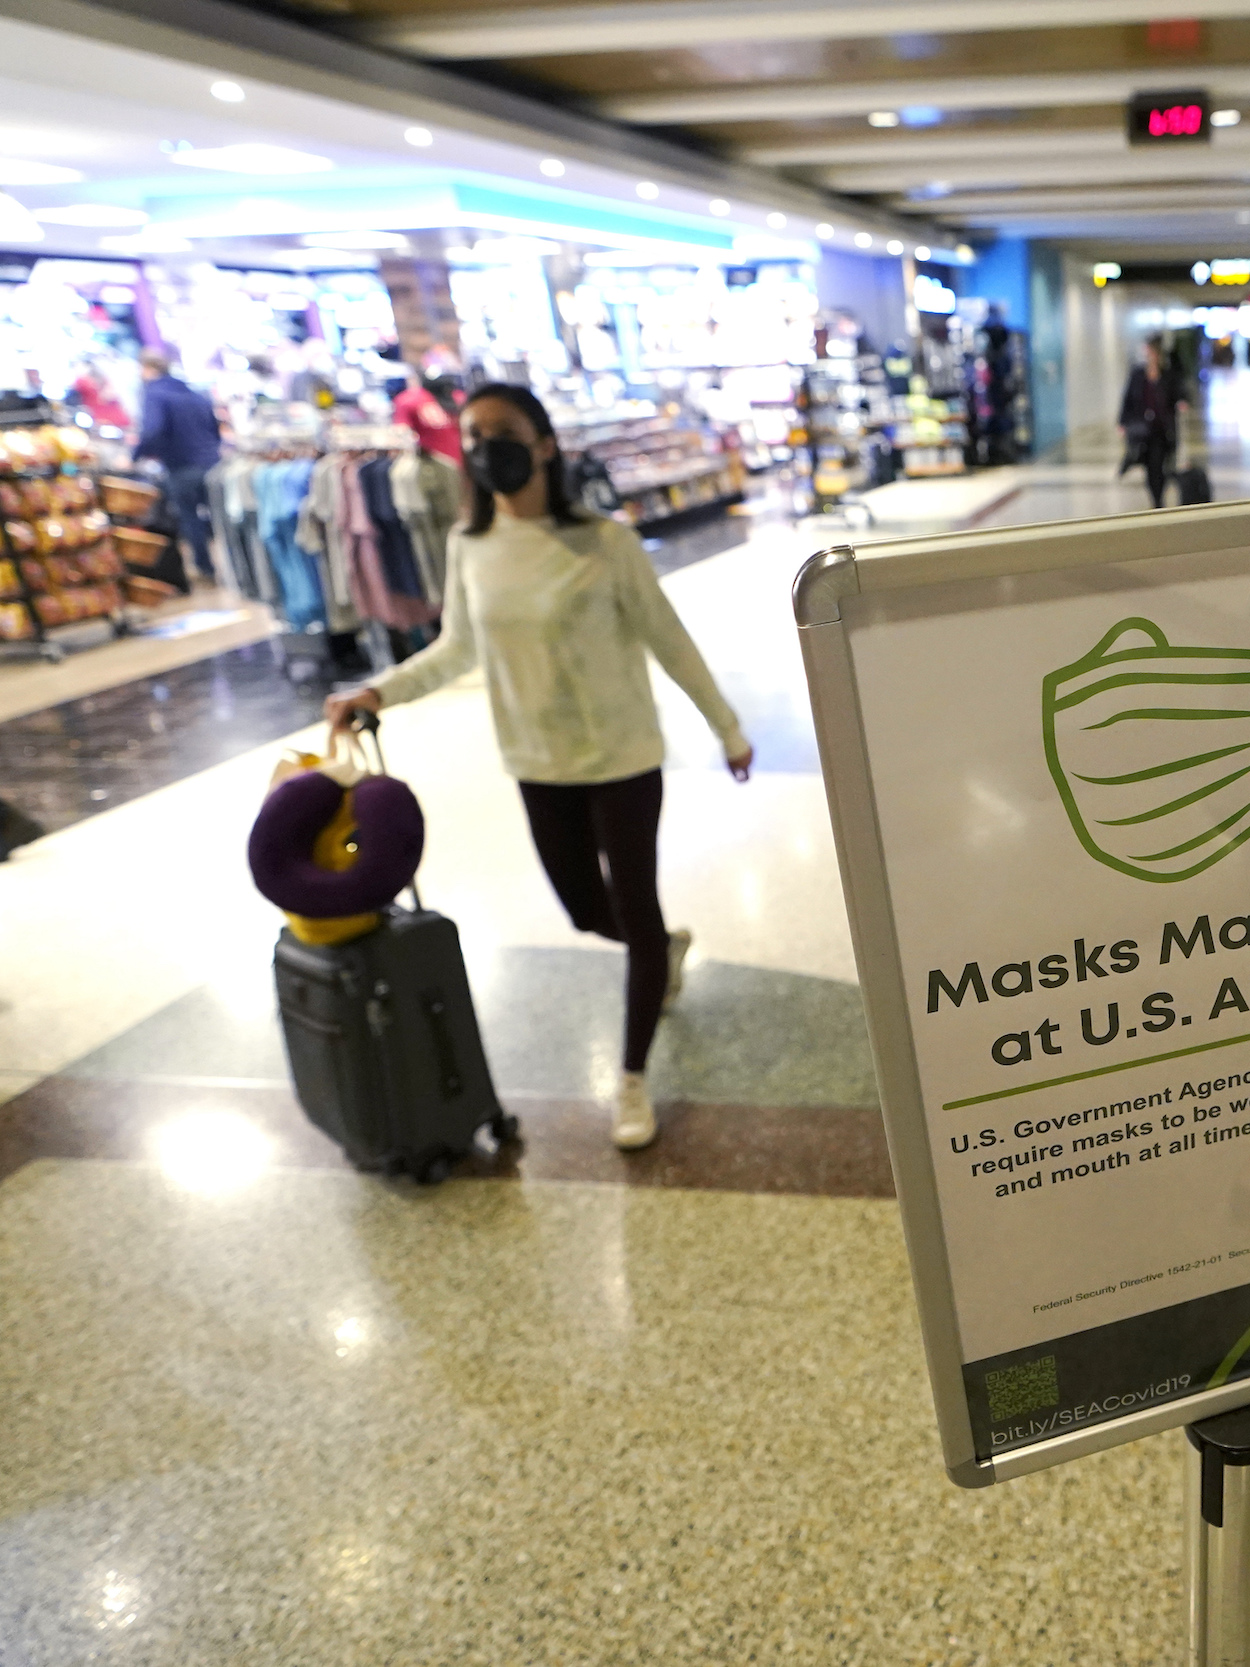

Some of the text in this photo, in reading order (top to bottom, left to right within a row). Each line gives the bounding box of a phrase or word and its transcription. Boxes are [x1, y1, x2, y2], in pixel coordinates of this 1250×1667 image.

[927, 938, 1140, 1014] Masks
[991, 1018, 1062, 1066] at
[1080, 992, 1192, 1046] U.S.
[951, 1129, 1005, 1154] U.S.
[1014, 1087, 1172, 1139] Government
[971, 1144, 1063, 1177] require
[1073, 1122, 1153, 1152] masks
[1161, 1114, 1184, 1130] to
[1193, 1105, 1221, 1123] be
[996, 1171, 1042, 1198] and
[1052, 1152, 1130, 1184] mouth
[1139, 1142, 1162, 1162] at
[1169, 1133, 1195, 1154] all
[1032, 1296, 1073, 1314] Federal
[1075, 1285, 1117, 1302] Security
[1119, 1272, 1164, 1290] Directive
[1167, 1254, 1222, 1276] 1542-21-01
[991, 1374, 1191, 1446] bit.ly/SEACovid19
